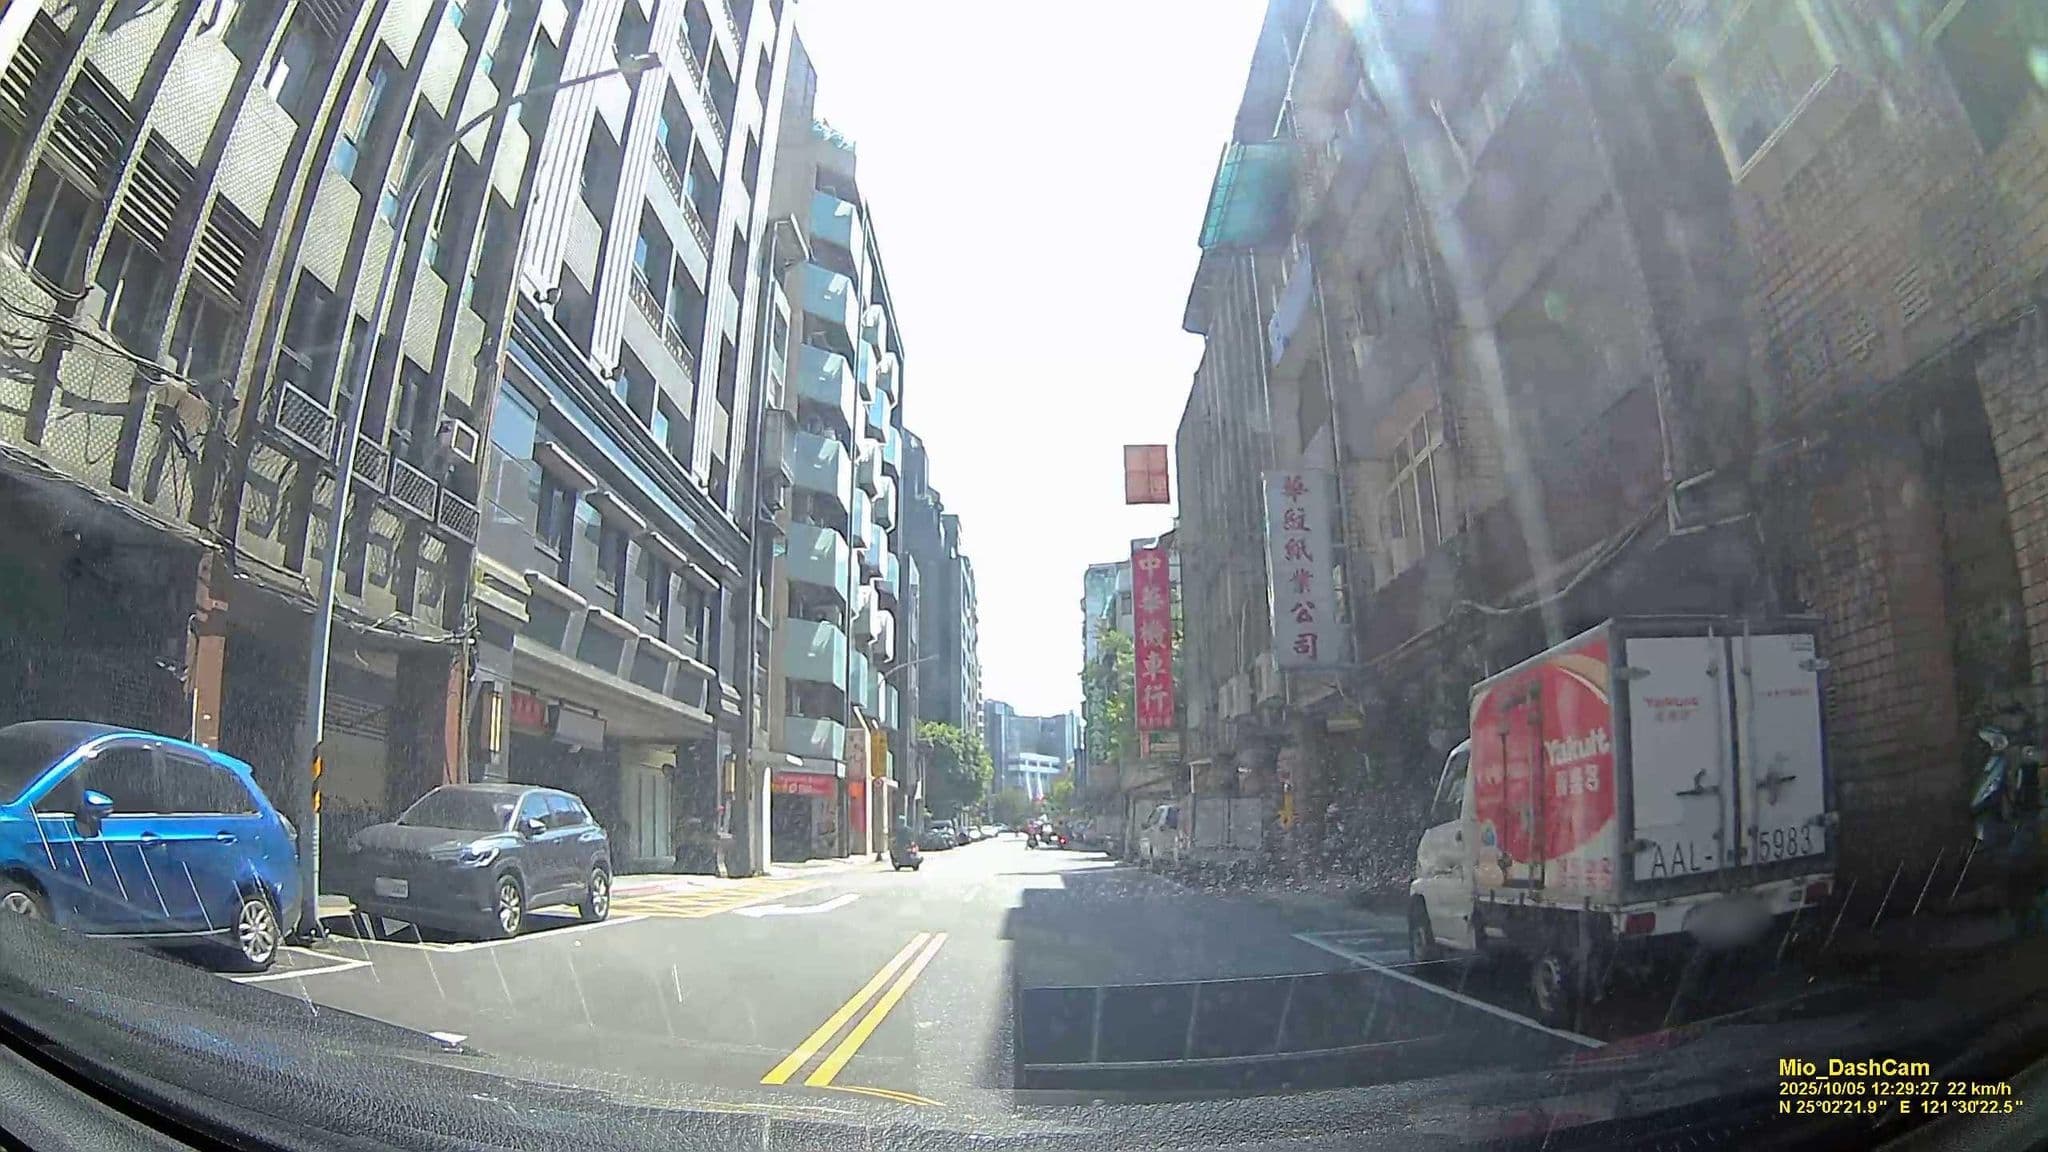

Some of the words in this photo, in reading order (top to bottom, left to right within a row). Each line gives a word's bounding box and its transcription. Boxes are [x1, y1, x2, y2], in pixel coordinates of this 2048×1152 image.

[1138, 552, 1168, 714] 中華機車行
[1544, 727, 1610, 767] Yakult
